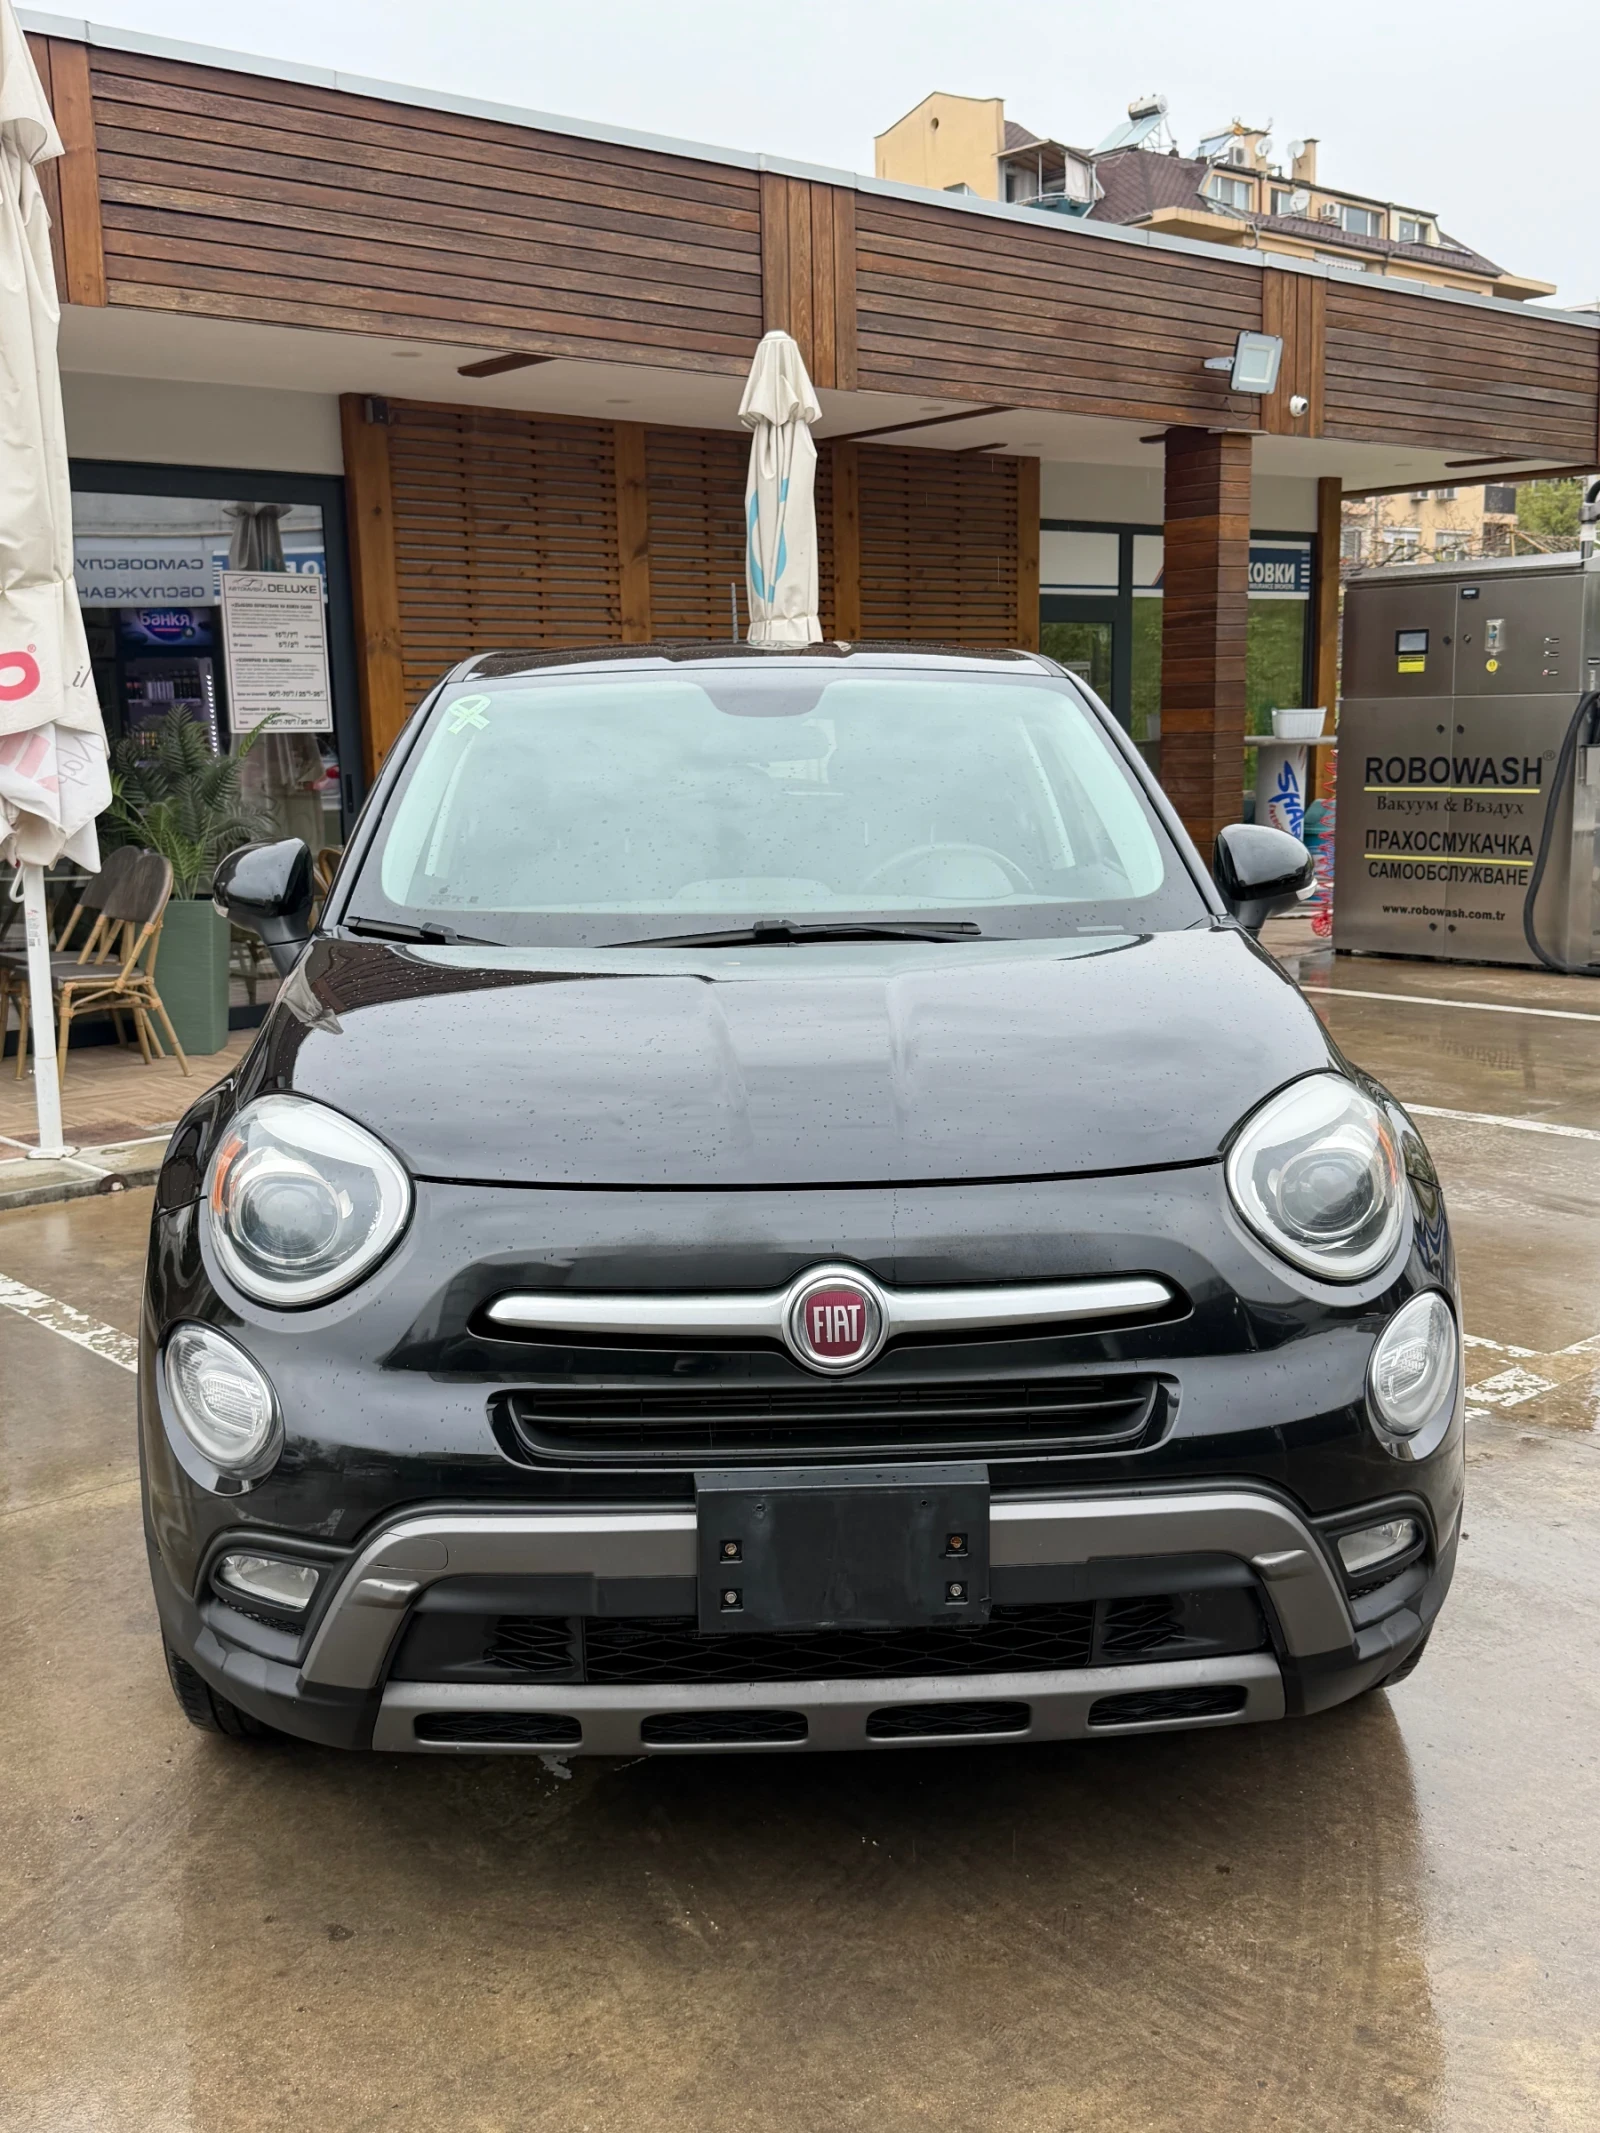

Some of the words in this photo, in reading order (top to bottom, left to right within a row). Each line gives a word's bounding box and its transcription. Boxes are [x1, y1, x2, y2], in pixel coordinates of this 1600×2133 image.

[267, 583, 317, 594] DELUXE
[140, 610, 190, 627] Банкя
[1365, 756, 1542, 785] ROBOWASH
[1377, 796, 1438, 816] Вакуум
[1444, 798, 1458, 812] &
[1463, 798, 1524, 819] Въздух
[1365, 830, 1533, 856] ПРАХОСМУКАЧКА
[1368, 861, 1529, 886] САМООБСЛУЖВАНЕ
[1382, 904, 1506, 921] www.robowash.com.tr
[813, 1304, 861, 1344] FIAT
